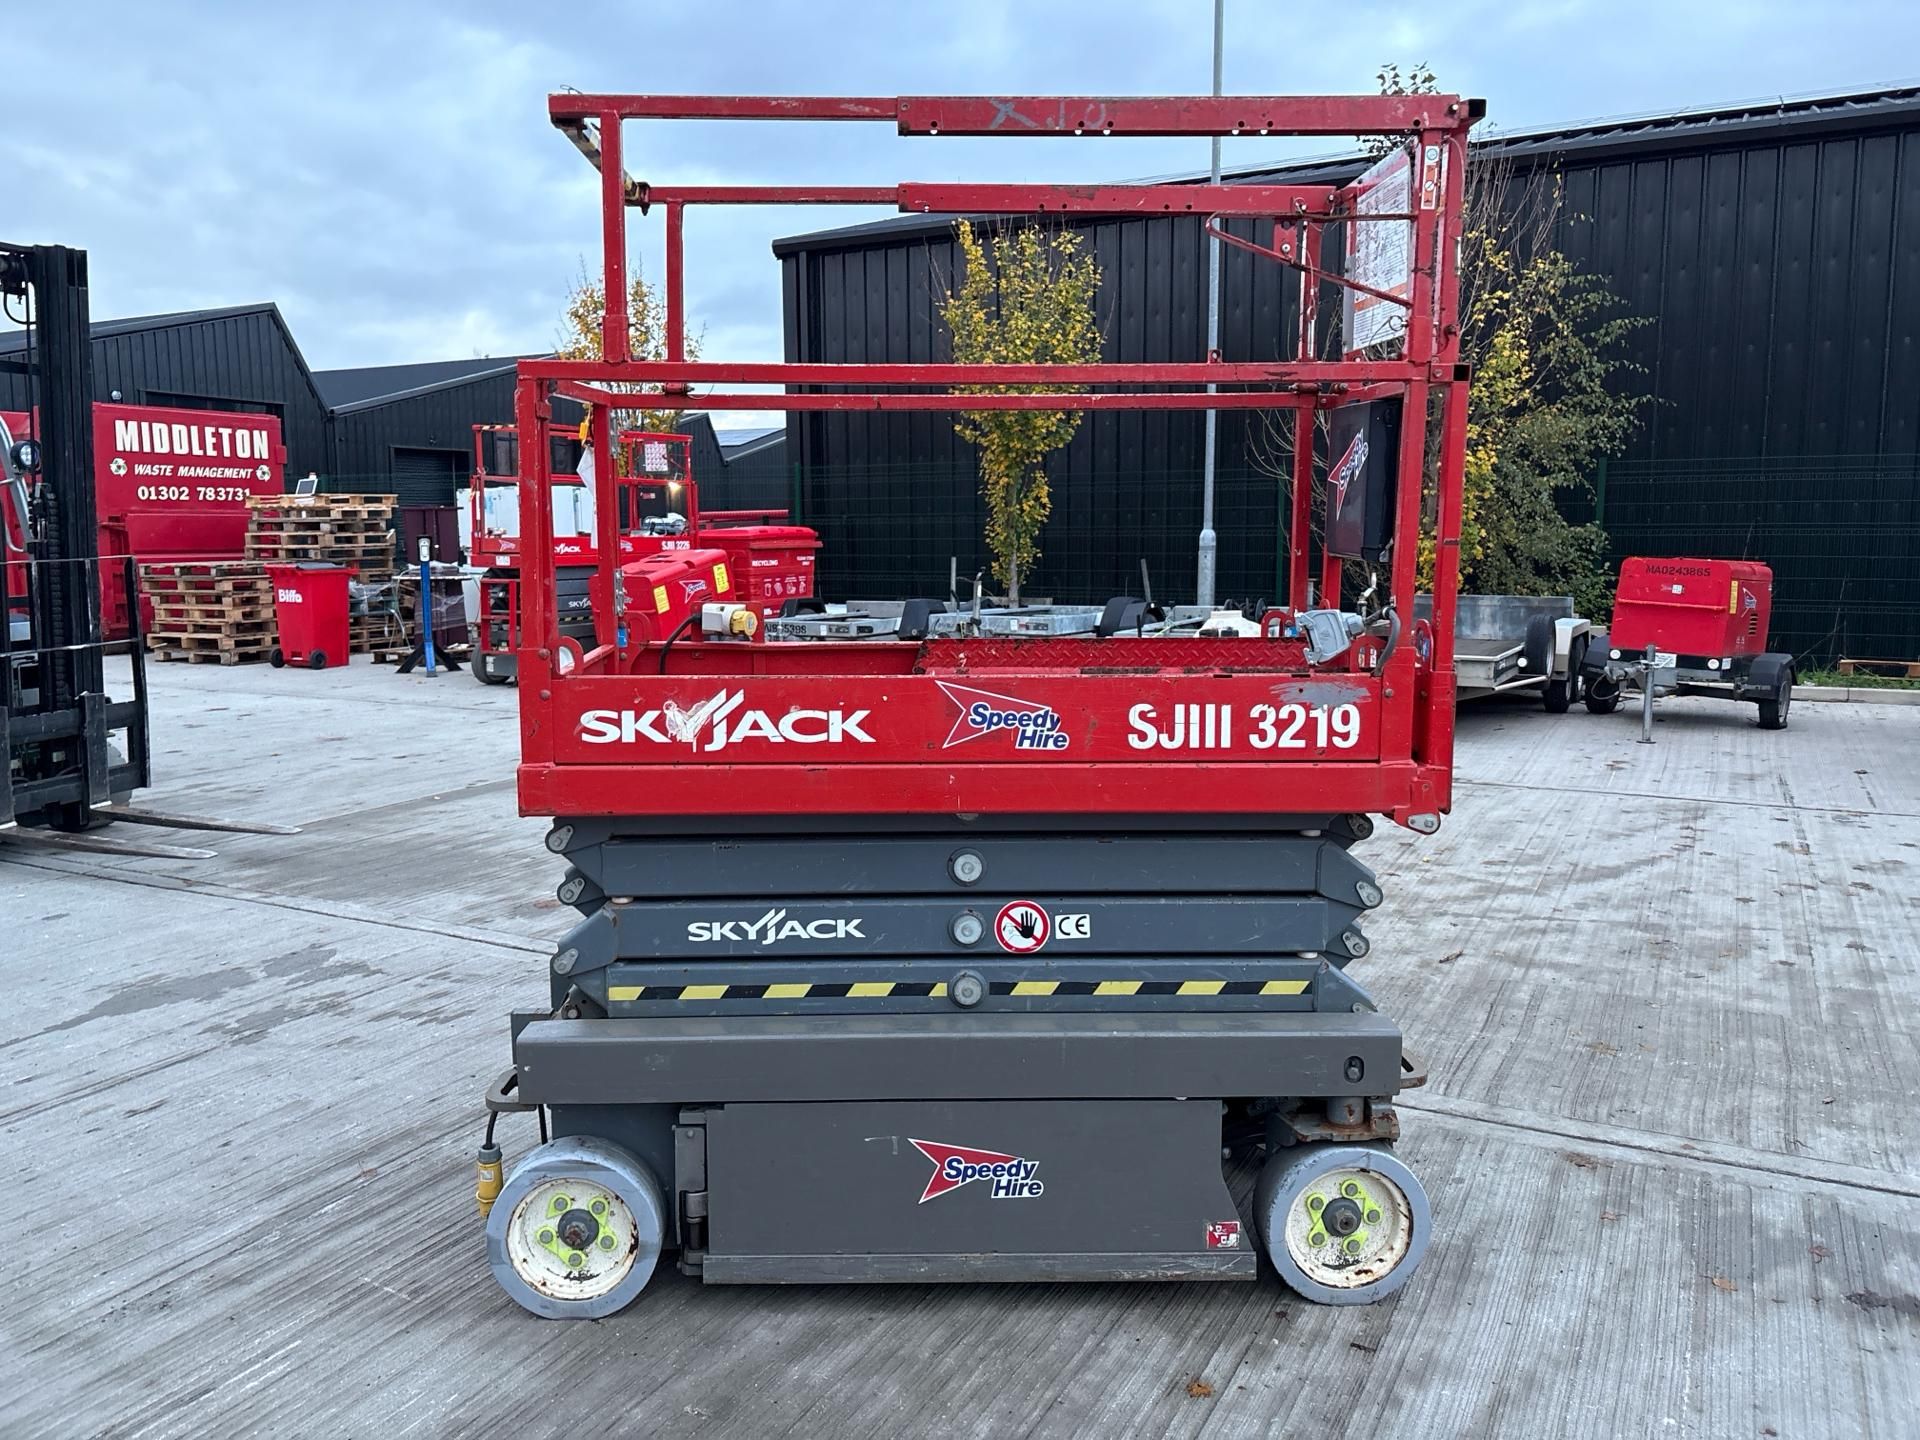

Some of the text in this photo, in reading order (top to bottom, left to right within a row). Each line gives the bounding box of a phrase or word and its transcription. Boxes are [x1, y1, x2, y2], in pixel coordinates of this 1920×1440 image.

[115, 419, 270, 460] MIDDLETON
[134, 464, 253, 479] WASTE MANAGEMENT
[137, 486, 250, 501] 01302 783731
[555, 543, 581, 554] YJACK
[568, 597, 591, 608] SKYJA
[581, 687, 876, 753] SKYJACK
[968, 703, 1062, 735] Speedy
[1128, 703, 1361, 750] SJIII 3219
[1016, 728, 1069, 749] Hire
[688, 908, 866, 945] SKYJACK
[1057, 916, 1088, 936] CE
[944, 1157, 1037, 1184] Speedy
[993, 1179, 1043, 1198] Hire
